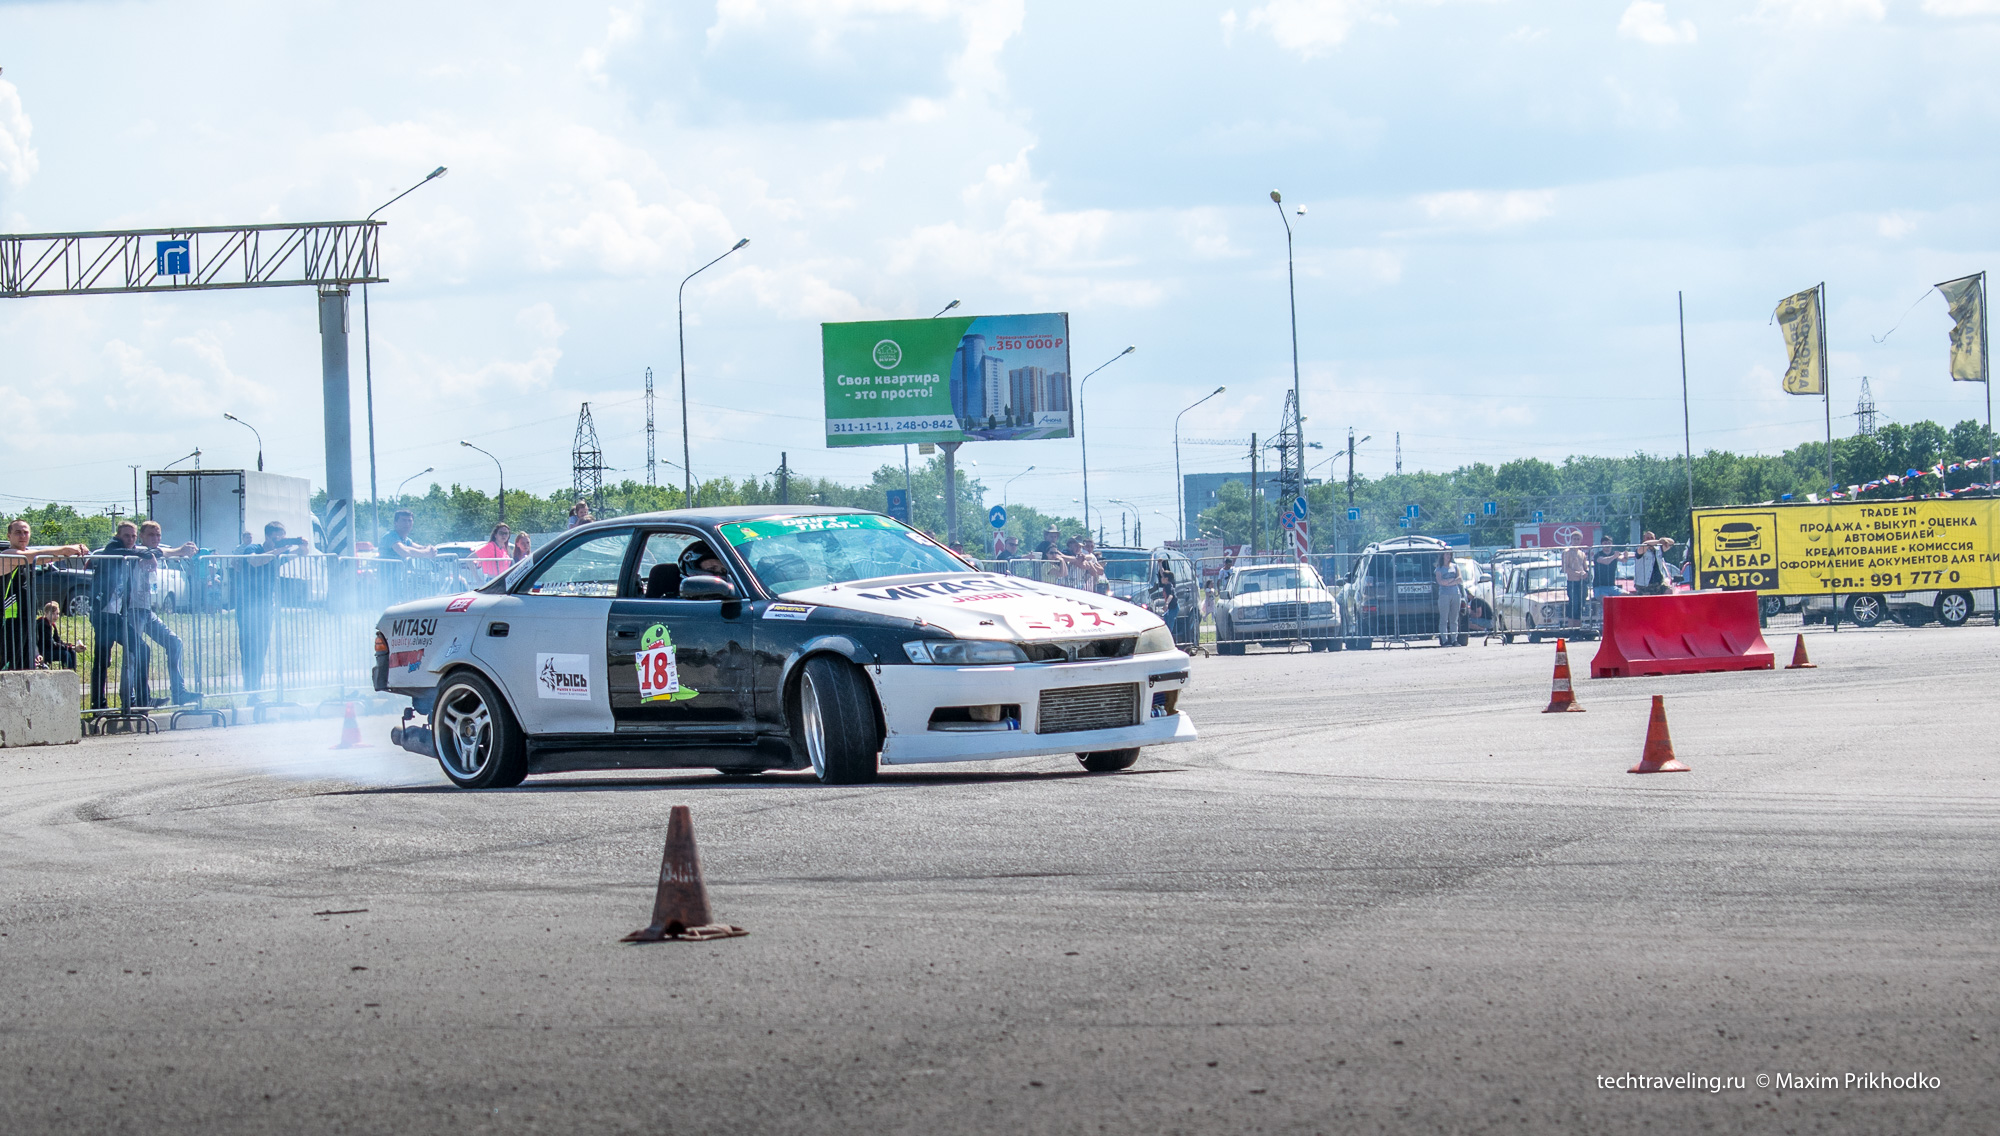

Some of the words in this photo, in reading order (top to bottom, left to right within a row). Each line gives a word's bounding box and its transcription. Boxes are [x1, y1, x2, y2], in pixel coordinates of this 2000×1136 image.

[996, 340, 1022, 351] 350
[837, 375, 870, 386] Своя
[875, 374, 940, 386] квартира
[854, 390, 877, 400] это
[881, 386, 933, 400] просто!
[896, 420, 953, 430] 248-0-842
[1860, 507, 1899, 518] TRADE
[1902, 506, 1917, 516] IN
[781, 516, 838, 527] DRIFT
[1800, 521, 1862, 533] ПРОДАЖА
[1874, 519, 1917, 530] ВЫКУП
[1928, 517, 1977, 529] ОЦЕНКА
[1844, 527, 1934, 543] АВТОМОБИЛЕЙ
[1805, 545, 1898, 557] КРЕДИТОВАНИЕ
[1909, 542, 1974, 553] КОМИССИЯ
[1707, 553, 1771, 568] АМБАР
[1780, 559, 1864, 570] ОФОРМЛЕНИЕ
[1868, 555, 1949, 568] ДОКУМЕНТОВ
[1951, 554, 1975, 565] ДЛЯ
[1979, 553, 2000, 563] ГАИ
[1820, 577, 1864, 588] тел.:
[1871, 572, 1902, 586] 991
[1910, 570, 1944, 585] 777
[1949, 570, 1960, 583] 0
[953, 592, 1023, 603] Japan
[392, 618, 439, 637] MITASU
[1020, 611, 1115, 629] ミタス
[641, 652, 668, 690] 18
[555, 674, 587, 687] РЫСЬ
